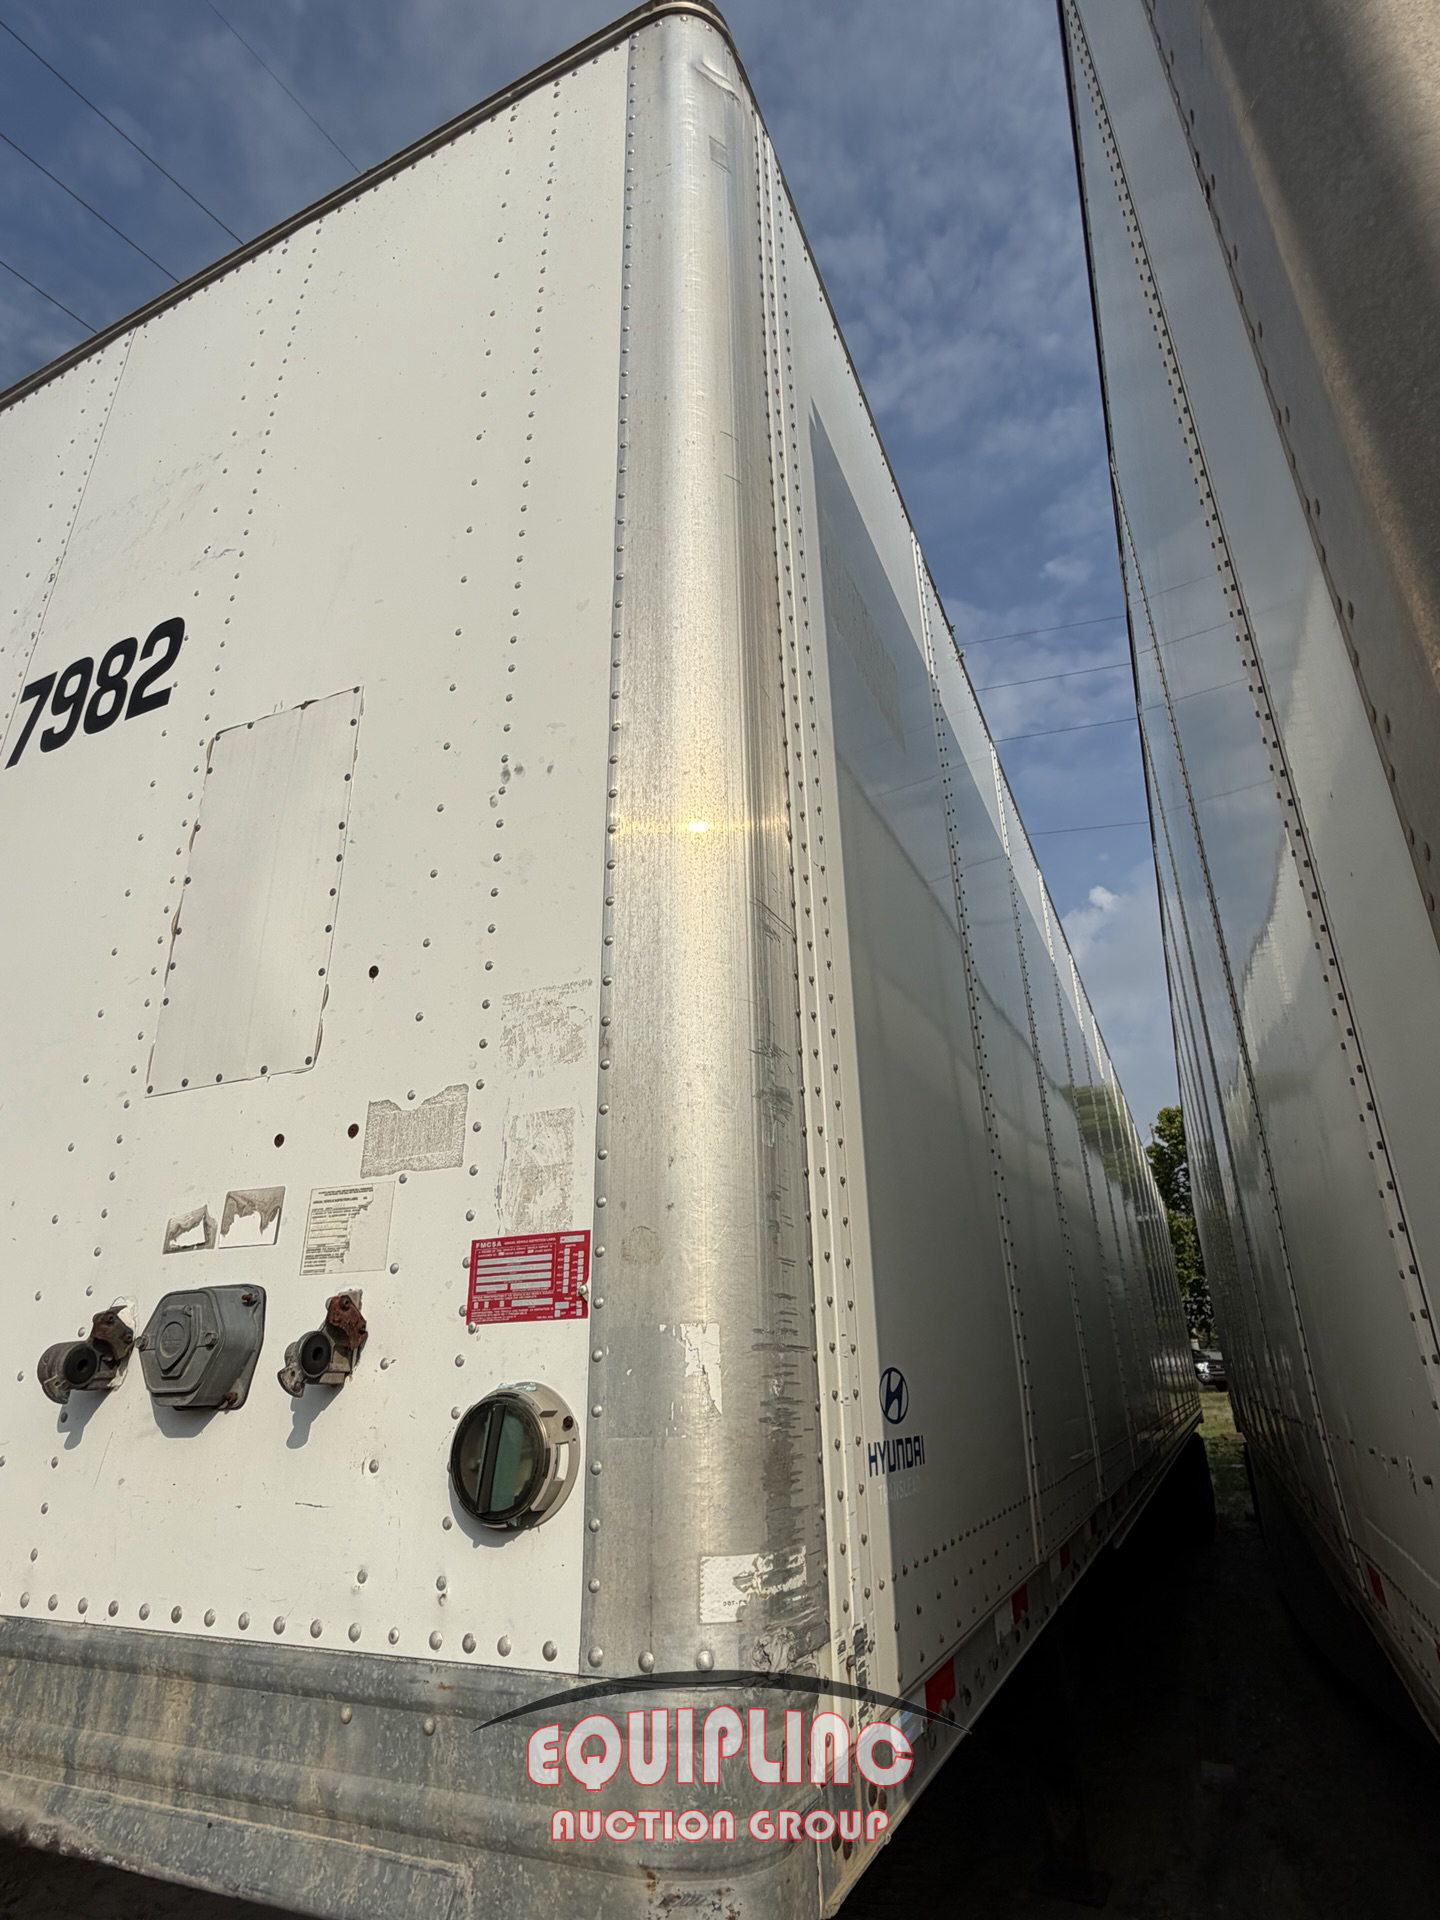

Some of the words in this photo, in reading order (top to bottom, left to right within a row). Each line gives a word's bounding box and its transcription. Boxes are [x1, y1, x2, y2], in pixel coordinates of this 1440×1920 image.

[4, 616, 186, 770] 7982
[475, 1241, 502, 1249] FMCSA
[868, 1435, 925, 1477] HYUNDAI
